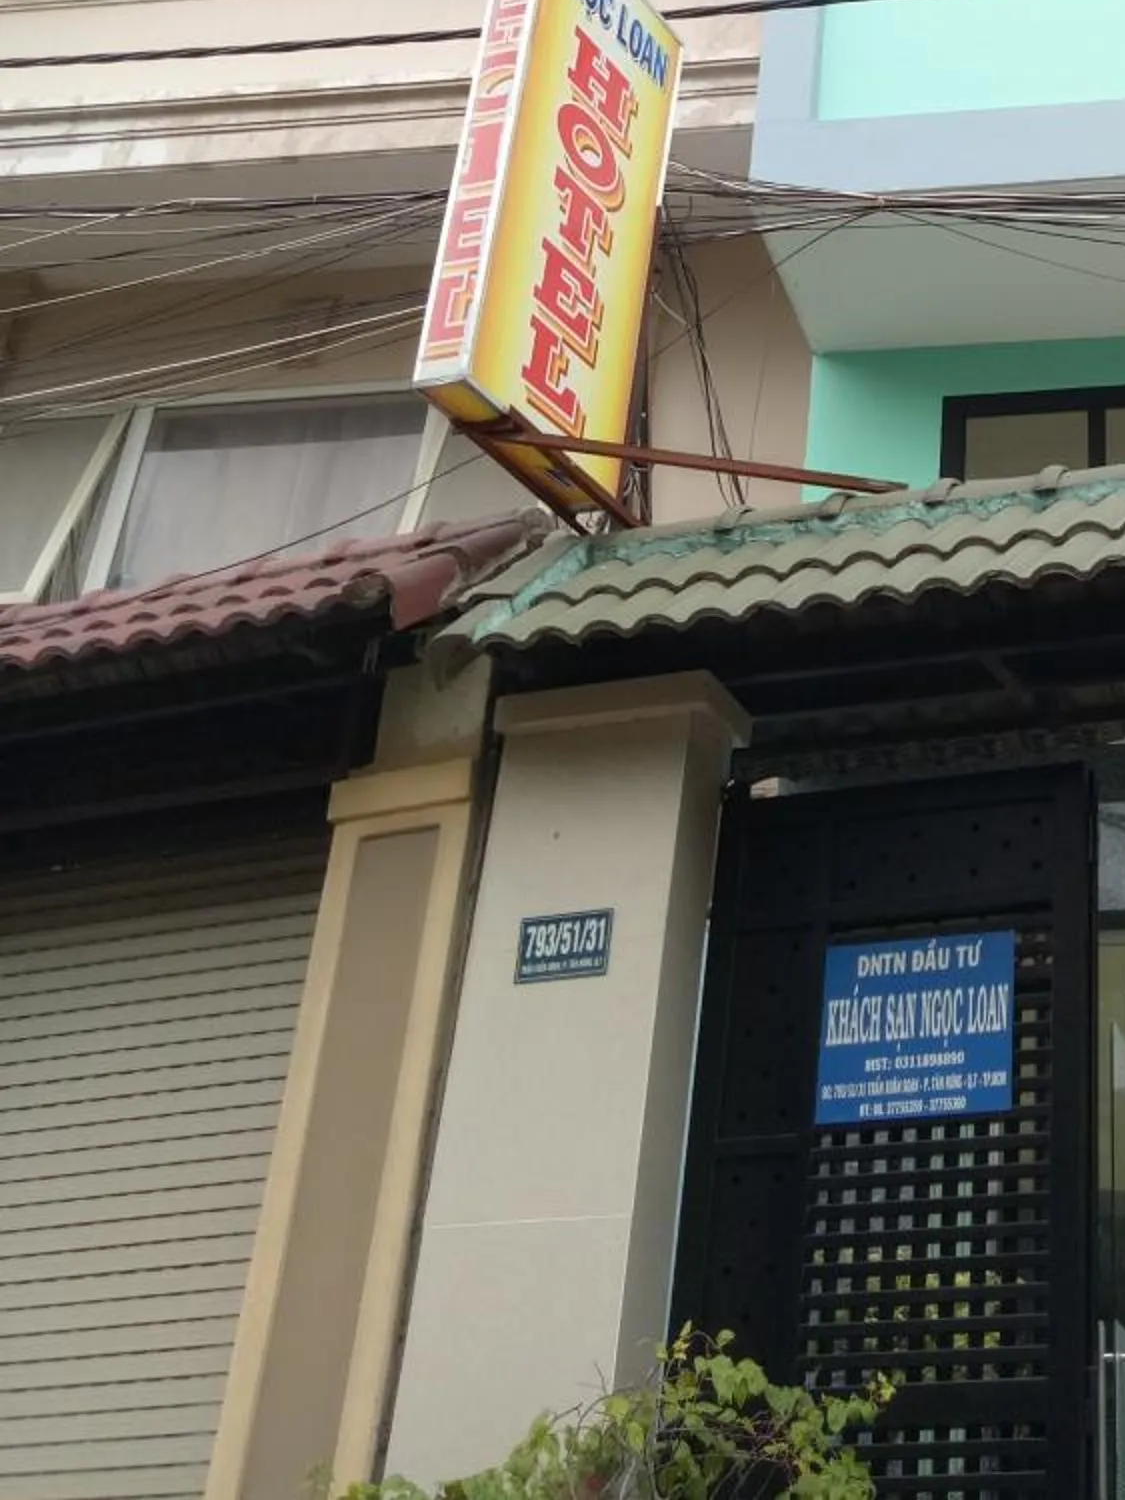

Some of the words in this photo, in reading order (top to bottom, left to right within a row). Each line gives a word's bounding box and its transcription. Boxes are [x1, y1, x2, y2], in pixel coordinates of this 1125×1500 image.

[617, 3, 668, 88] LOAN
[522, 24, 638, 438] HOTEL
[525, 918, 607, 959] 793/51/31
[857, 952, 906, 977] DNTN
[956, 940, 983, 968] TƯ
[825, 984, 883, 1046] KHÁCH
[885, 991, 918, 1052] SẠN
[920, 989, 964, 1048] NGỌC
[967, 983, 1010, 1034] LOAN
